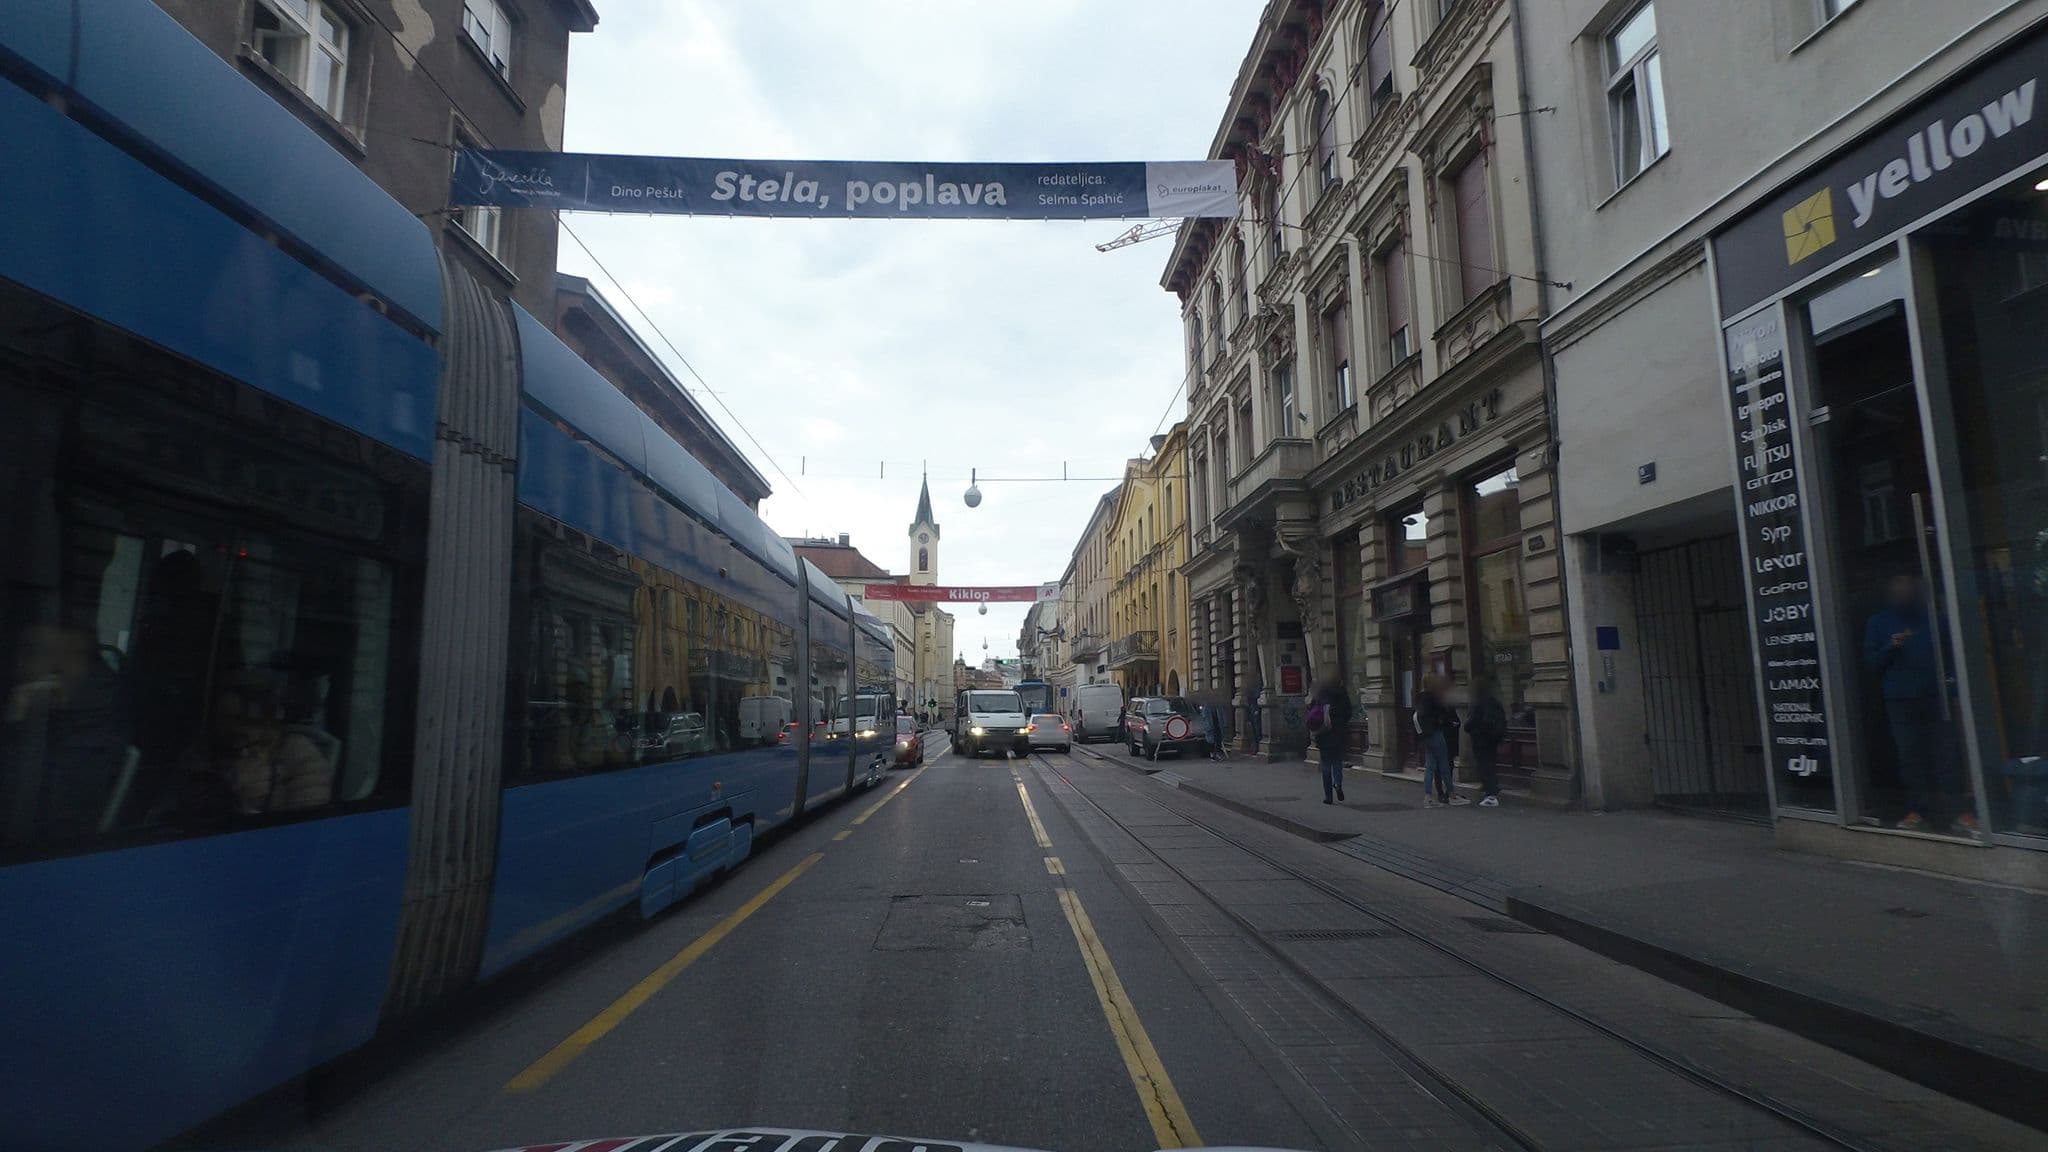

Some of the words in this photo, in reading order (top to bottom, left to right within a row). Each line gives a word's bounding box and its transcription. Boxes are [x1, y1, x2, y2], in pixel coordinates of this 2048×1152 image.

[1847, 78, 2037, 228] yellow
[611, 185, 642, 199] Dino
[646, 183, 683, 200] Pešut
[711, 171, 830, 210] Stela,
[845, 174, 1007, 211] poplava
[1037, 173, 1106, 192] redateljica:
[1172, 184, 1221, 194] europlakat
[1038, 194, 1077, 206] Selma
[1738, 392, 1785, 420] Lowepro
[1740, 418, 1787, 443] SanDisk
[1332, 387, 1503, 513] RESTAURANT
[1747, 468, 1794, 490] GITZO
[1750, 493, 1797, 517] NIKKOR
[1755, 552, 1804, 574] Lexar
[949, 588, 990, 601] Kiklop
[1759, 581, 1808, 596] GoPro
[1763, 603, 1810, 623] JOBY
[1769, 677, 1820, 691] LAMAX
[1772, 702, 1812, 712] NATIONAL
[1774, 712, 1824, 723] GEOGRAPHIC
